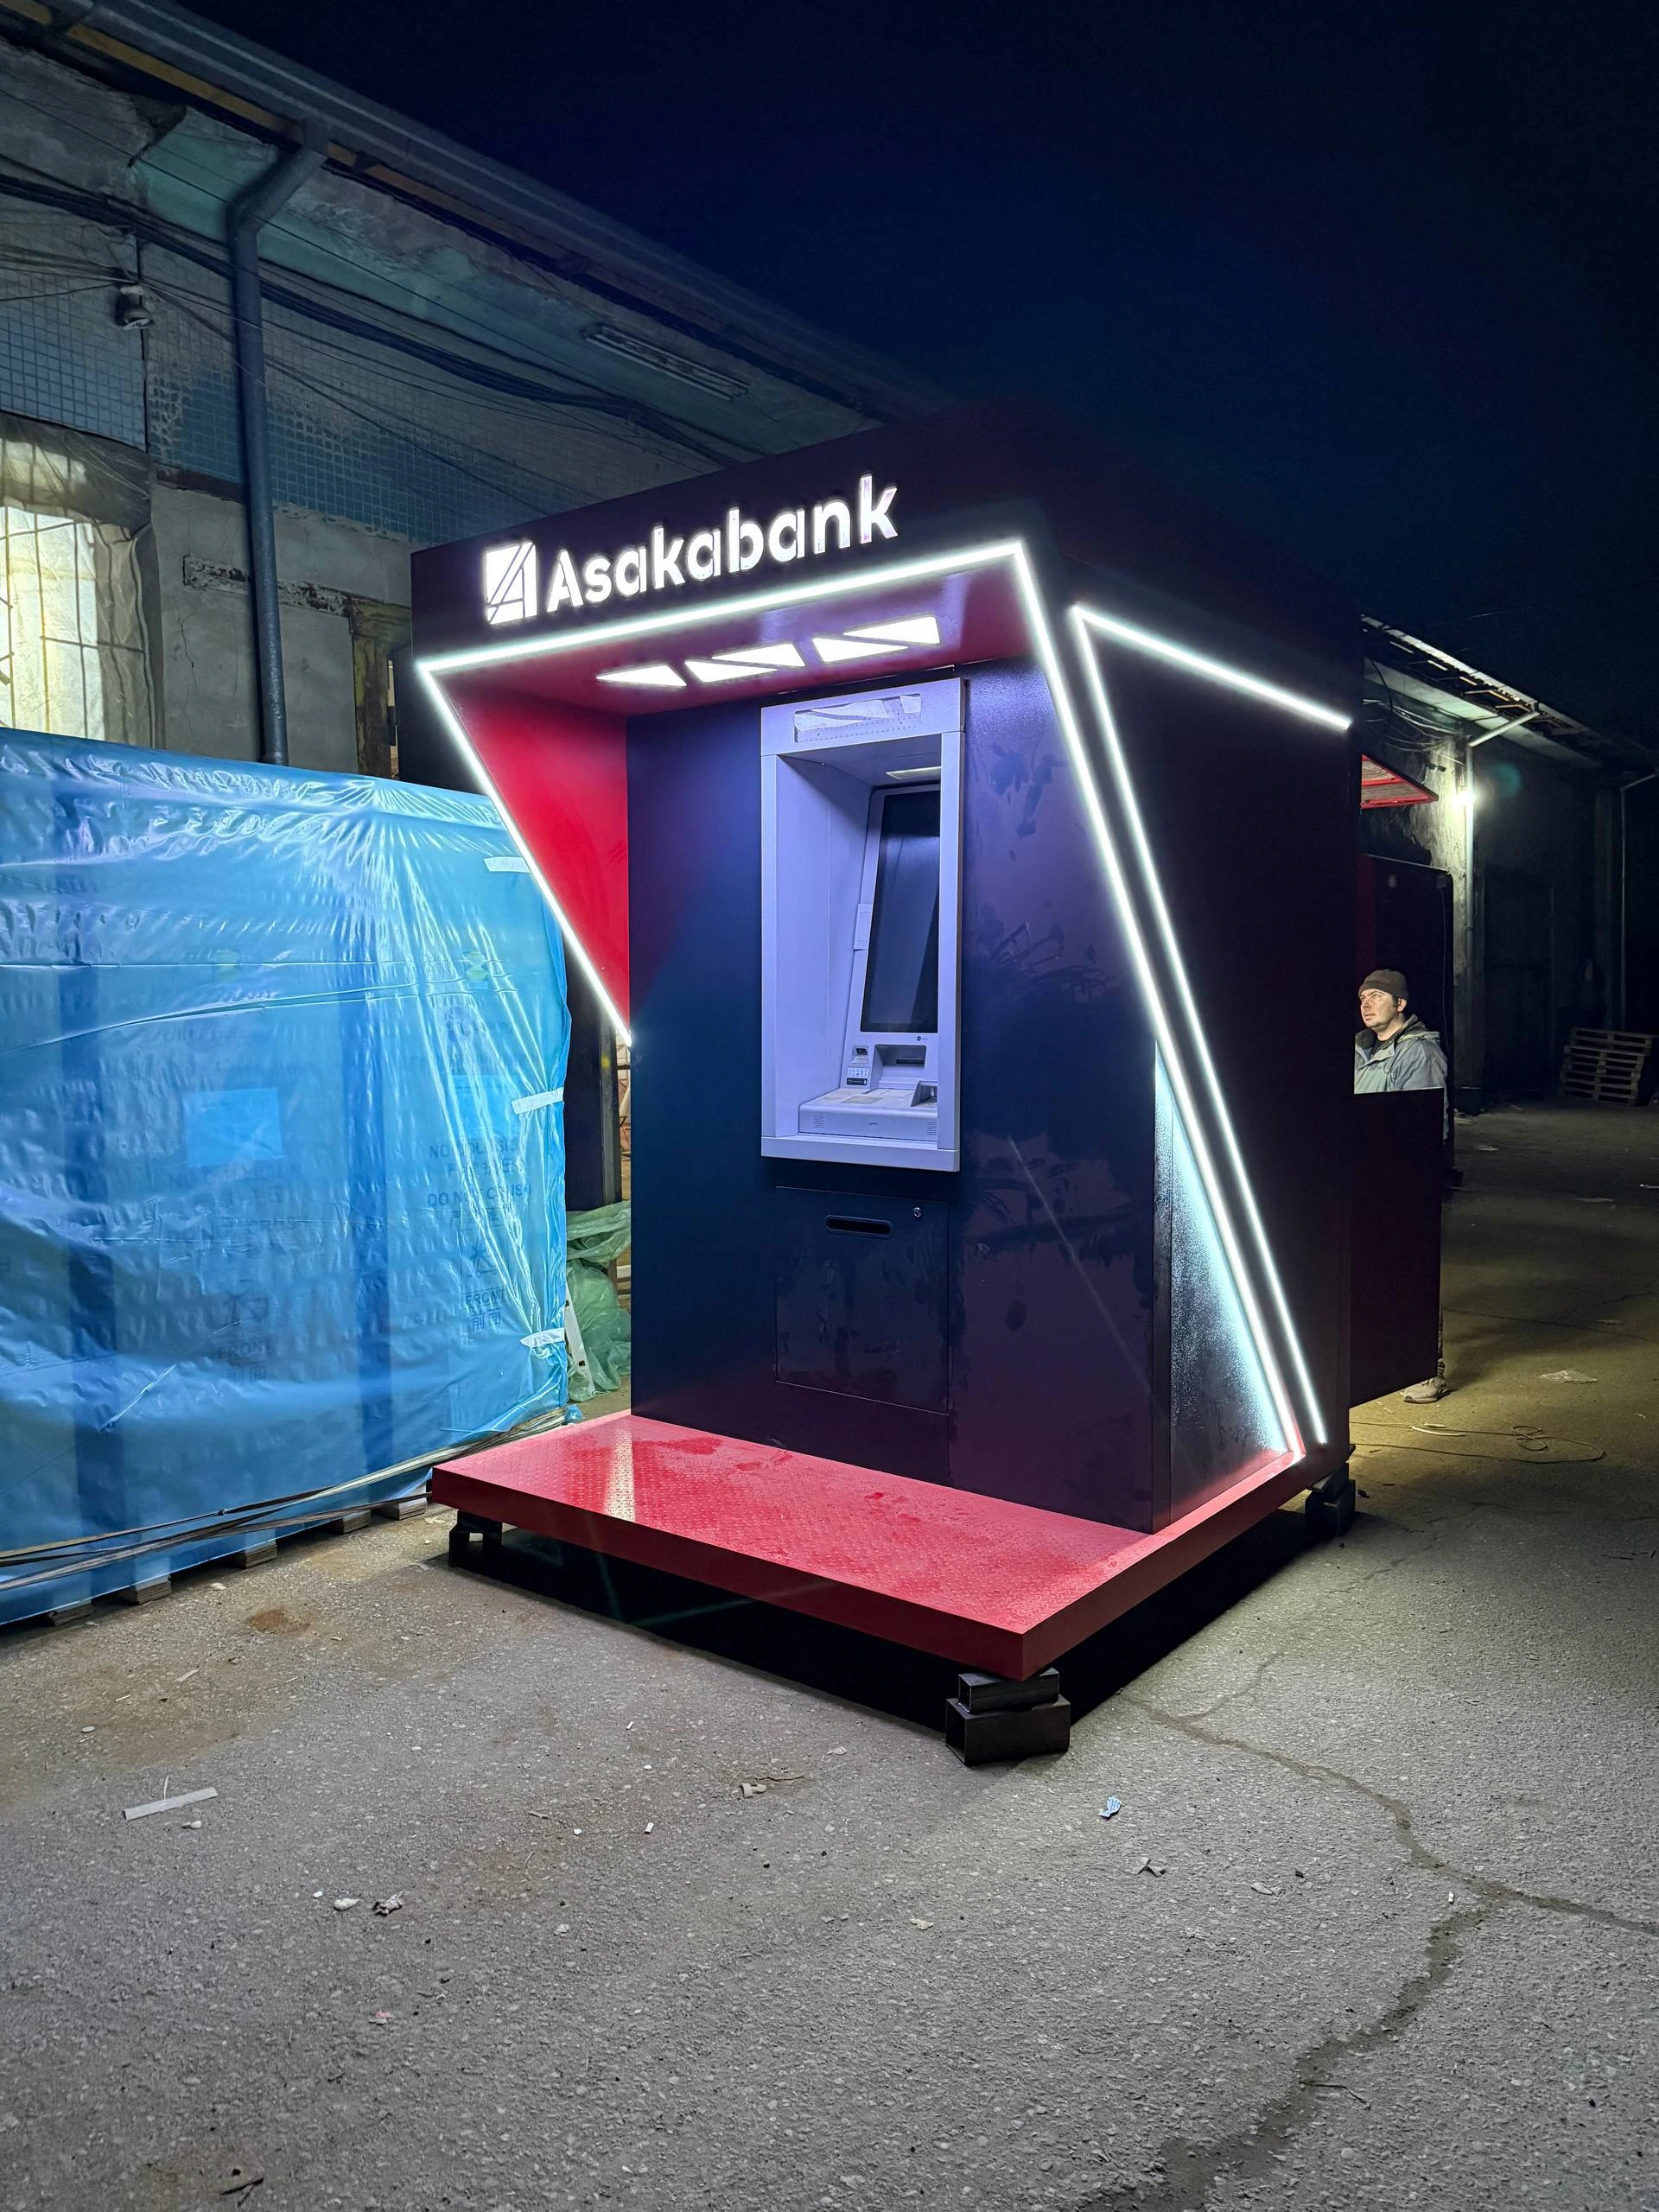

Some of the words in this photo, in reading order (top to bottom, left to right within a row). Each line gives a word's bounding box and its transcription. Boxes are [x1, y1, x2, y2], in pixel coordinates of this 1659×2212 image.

[545, 474, 899, 614] Asakabank
[428, 1192, 449, 1207] DO
[465, 1289, 505, 1305] FRONT
